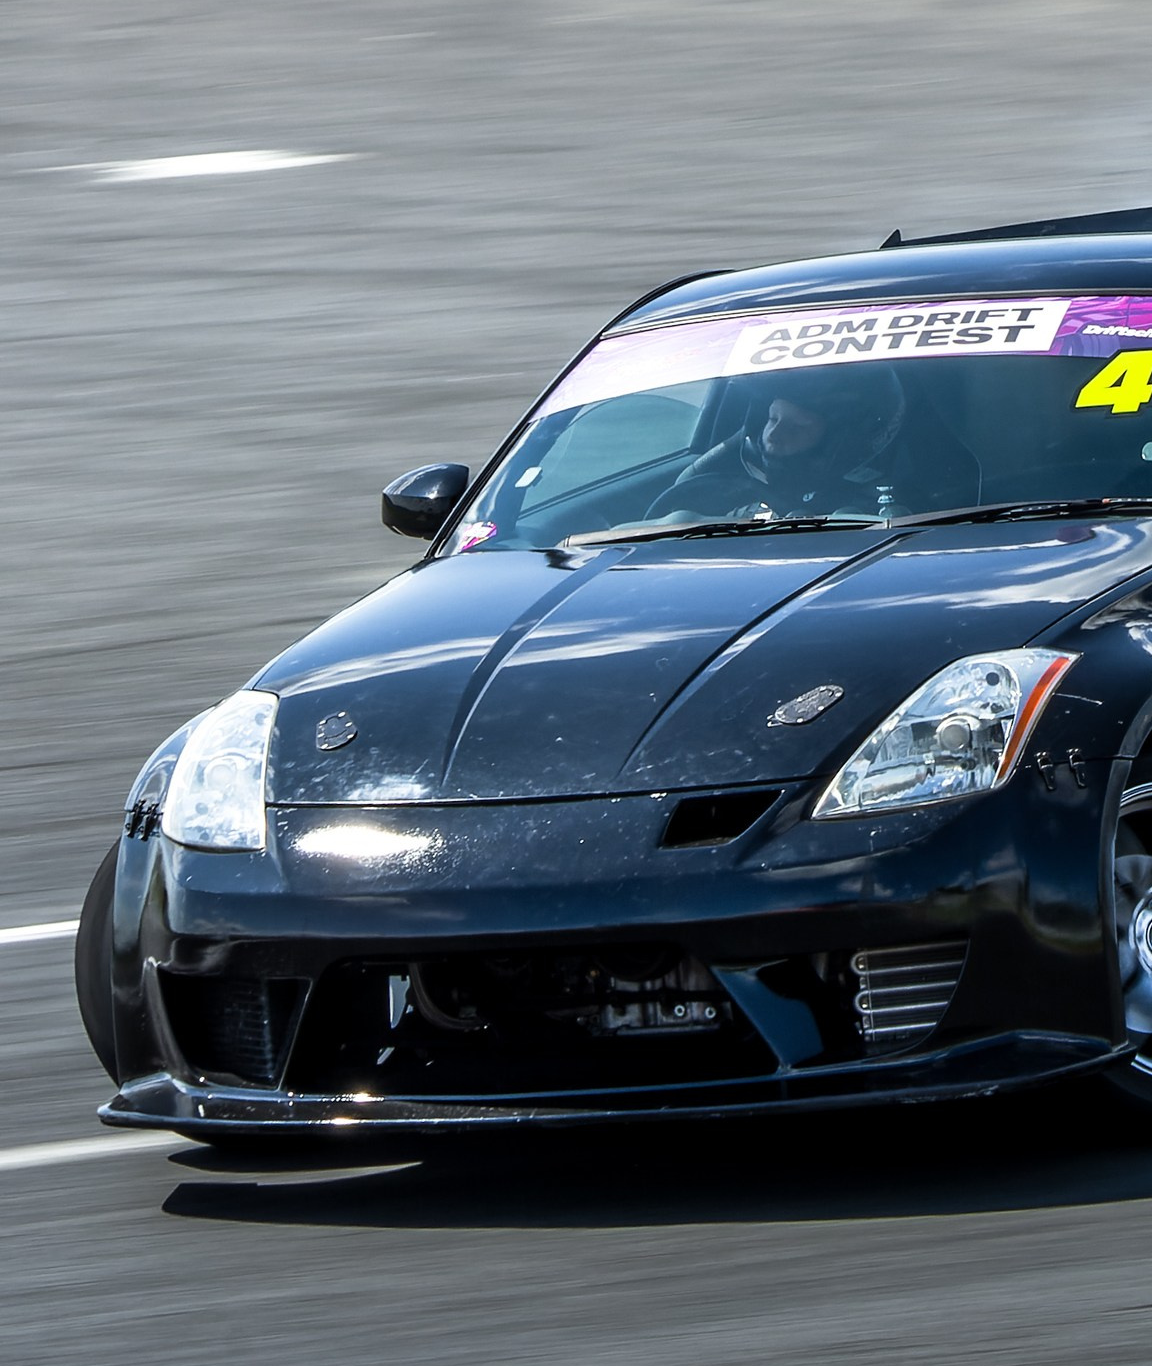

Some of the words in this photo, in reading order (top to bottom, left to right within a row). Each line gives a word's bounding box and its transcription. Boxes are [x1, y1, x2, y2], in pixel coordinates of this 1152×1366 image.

[749, 325, 1036, 366] CONTEST
[759, 317, 878, 345] ADM
[888, 307, 1045, 330] DRIFT
